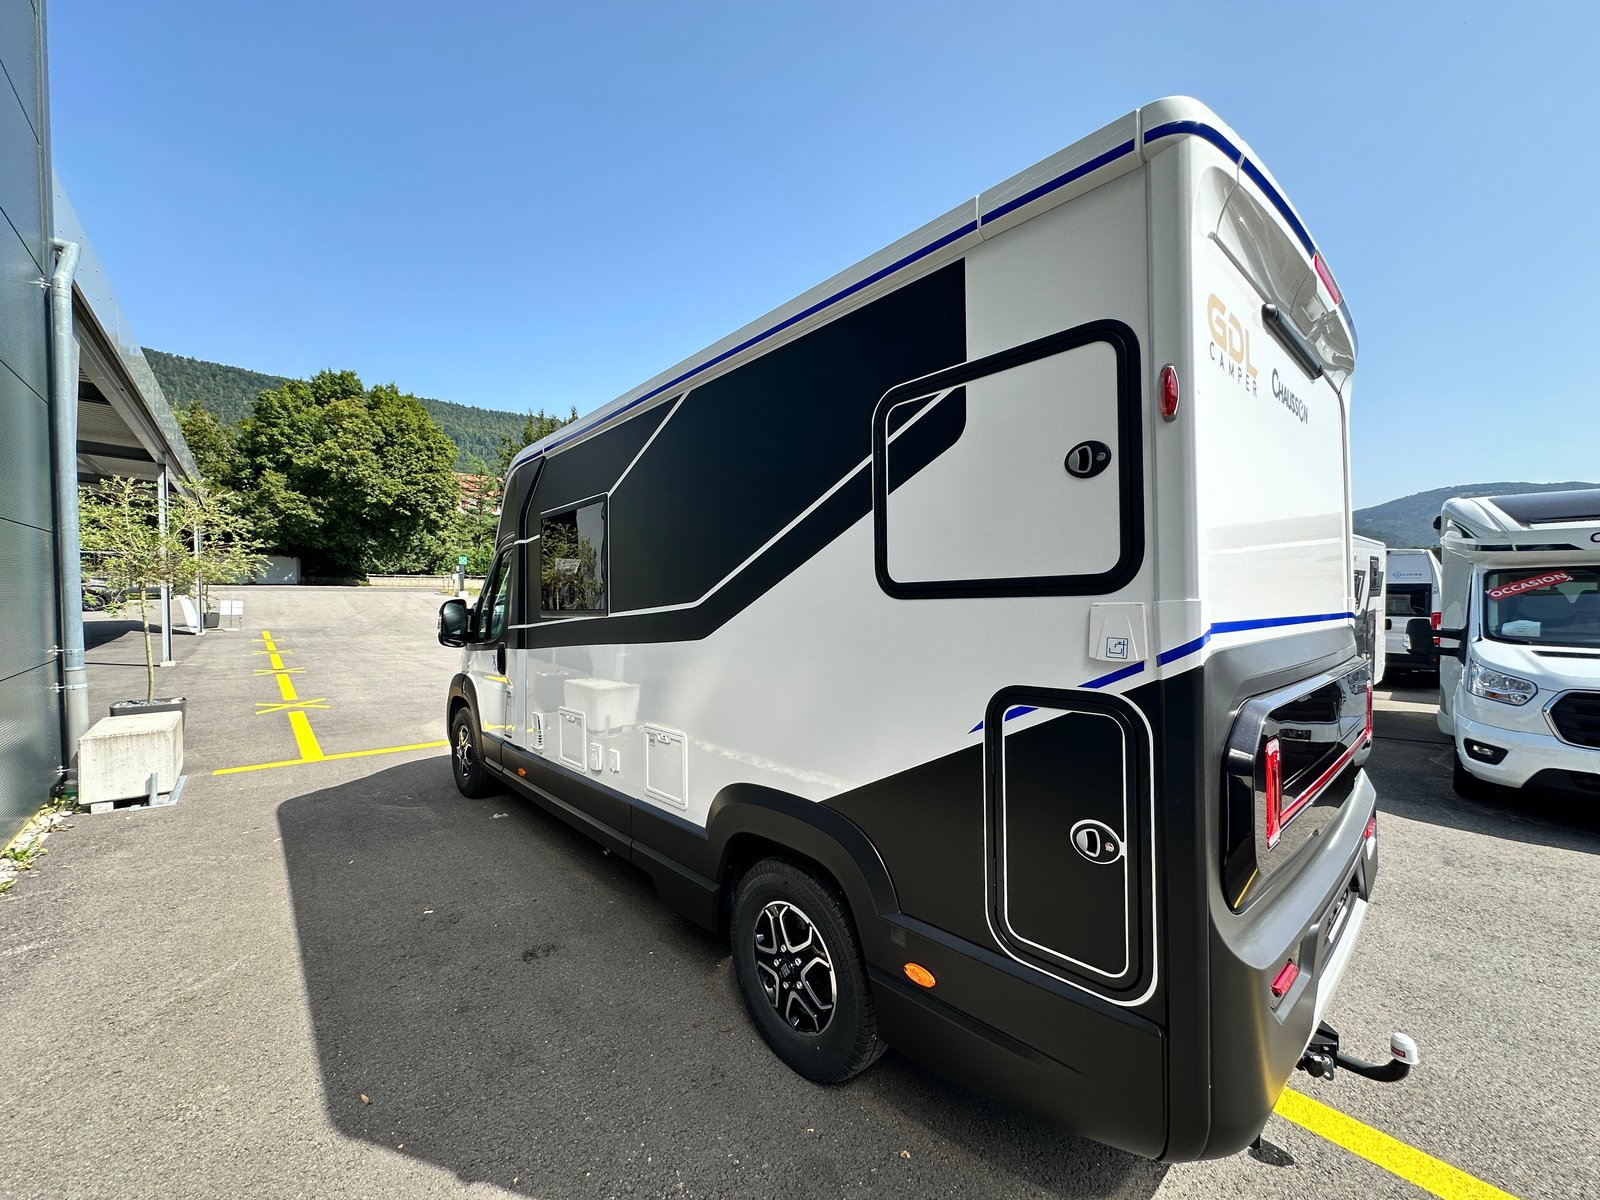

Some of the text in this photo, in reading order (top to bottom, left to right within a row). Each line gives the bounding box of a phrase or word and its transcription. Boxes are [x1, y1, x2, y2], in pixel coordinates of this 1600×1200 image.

[1207, 293, 1258, 380] GDL
[1209, 341, 1258, 399] CAMPER
[1271, 368, 1309, 424] CHAUSSON
[1490, 572, 1568, 598] OCCASION
